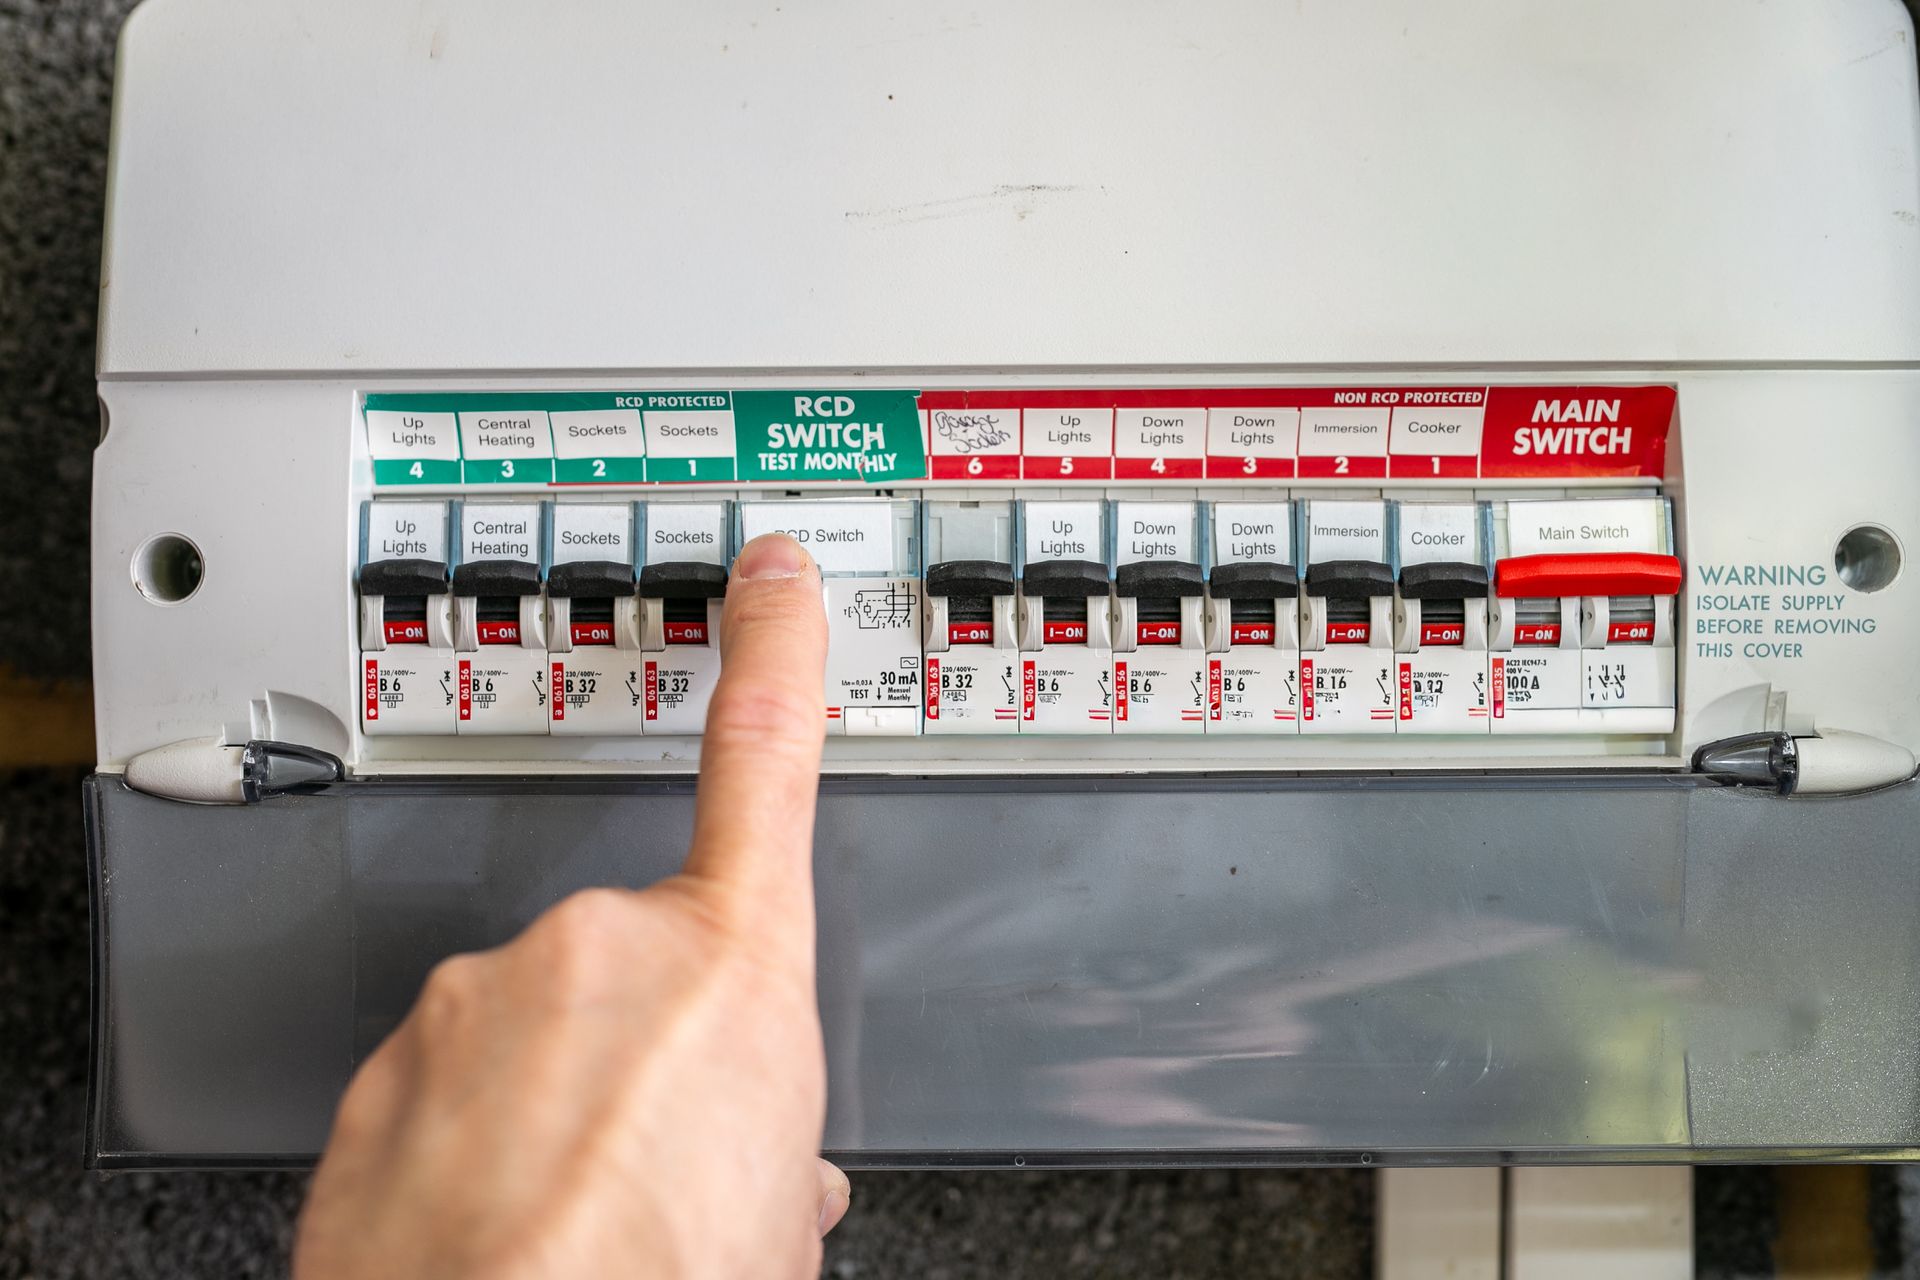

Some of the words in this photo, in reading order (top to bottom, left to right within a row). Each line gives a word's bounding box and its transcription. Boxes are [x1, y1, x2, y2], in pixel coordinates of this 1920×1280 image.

[616, 396, 643, 408] RCD
[649, 396, 726, 407] PROTECTED
[1334, 392, 1366, 404] NON
[1372, 392, 1399, 404] RCD
[1404, 392, 1482, 403] PROTECTED
[794, 396, 855, 417] RCD
[1531, 400, 1621, 422] MAIN
[403, 417, 424, 429] Up
[478, 419, 530, 430] Central
[1060, 416, 1080, 427] Up
[1142, 416, 1184, 428] Down
[1234, 416, 1275, 427] Down
[1408, 421, 1461, 434] Cooker
[568, 425, 627, 437] Sockets
[660, 424, 718, 436] Sockets
[768, 422, 886, 449] SWITCH
[1314, 424, 1378, 434] Immersion
[392, 432, 436, 446] Lights
[479, 434, 535, 448] Heating
[1048, 431, 1091, 445] Lights
[1140, 432, 1184, 446] Lights
[1231, 432, 1274, 446] Lights
[1512, 426, 1632, 456] SWITCH
[409, 461, 424, 478] 4
[501, 461, 514, 478] 3
[593, 460, 606, 477] 2
[688, 460, 696, 476] 1
[758, 453, 798, 470] TEST
[804, 452, 897, 473] MONTHLY
[968, 457, 983, 474] 6
[1060, 458, 1073, 474] 5
[1150, 458, 1165, 473] 4
[1243, 457, 1257, 474] 3
[1334, 457, 1349, 474] 2
[1431, 457, 1440, 474] 1
[396, 520, 416, 534] Up
[473, 521, 526, 535] Central
[1052, 520, 1072, 535] Up
[1134, 521, 1176, 535] Down
[1232, 522, 1273, 535] Down
[1314, 525, 1379, 538] Immersion
[1539, 527, 1575, 540] Main
[1580, 525, 1629, 540] Switch
[561, 531, 620, 545] Sockets
[655, 529, 714, 544] Sockets
[775, 530, 809, 542] CD
[816, 529, 864, 542] Switch
[1412, 531, 1465, 545] Cooker
[384, 540, 427, 556] Lights
[471, 542, 528, 557] Heating
[1041, 540, 1084, 557] Lights
[1132, 542, 1176, 558] Lights
[1232, 542, 1276, 558] Lights
[1698, 565, 1826, 586] WARNING
[1696, 595, 1770, 611] ISOLATE
[1782, 595, 1845, 611] SUPPLY
[1696, 619, 1763, 634] BEFORE
[1775, 618, 1876, 634] REMOVING
[1696, 643, 1733, 658] THIS
[1743, 643, 1803, 658] COVER
[368, 668, 376, 680] 56
[461, 669, 469, 680] 56
[554, 671, 562, 682] 63
[647, 670, 655, 681] 63
[880, 672, 896, 685] 30
[899, 672, 917, 685] mA
[930, 667, 938, 679] 63
[1025, 669, 1033, 680] 56
[1117, 670, 1125, 682] 56
[1212, 668, 1220, 680] 56
[1303, 667, 1312, 679] 60
[1401, 671, 1410, 683] 63
[380, 678, 387, 691] B
[393, 678, 401, 691] 6
[473, 679, 480, 691] B
[486, 678, 493, 691] 6
[566, 680, 573, 693] B
[579, 679, 596, 693] 32
[659, 679, 666, 692] B
[672, 678, 688, 692] 32
[942, 675, 950, 688] B
[956, 674, 972, 688] 32
[1038, 679, 1045, 691] B
[1051, 678, 1058, 691] 6
[1131, 679, 1138, 692] B
[1144, 679, 1151, 692] 6
[1224, 678, 1231, 691] B
[1238, 678, 1245, 691] 6
[1331, 676, 1346, 689] 16
[1506, 676, 1528, 689] 100
[1531, 676, 1539, 689] A
[368, 683, 376, 700] 061
[461, 684, 469, 700] 061
[554, 686, 562, 702] 061
[647, 685, 655, 701] 061
[850, 689, 869, 699] TEST
